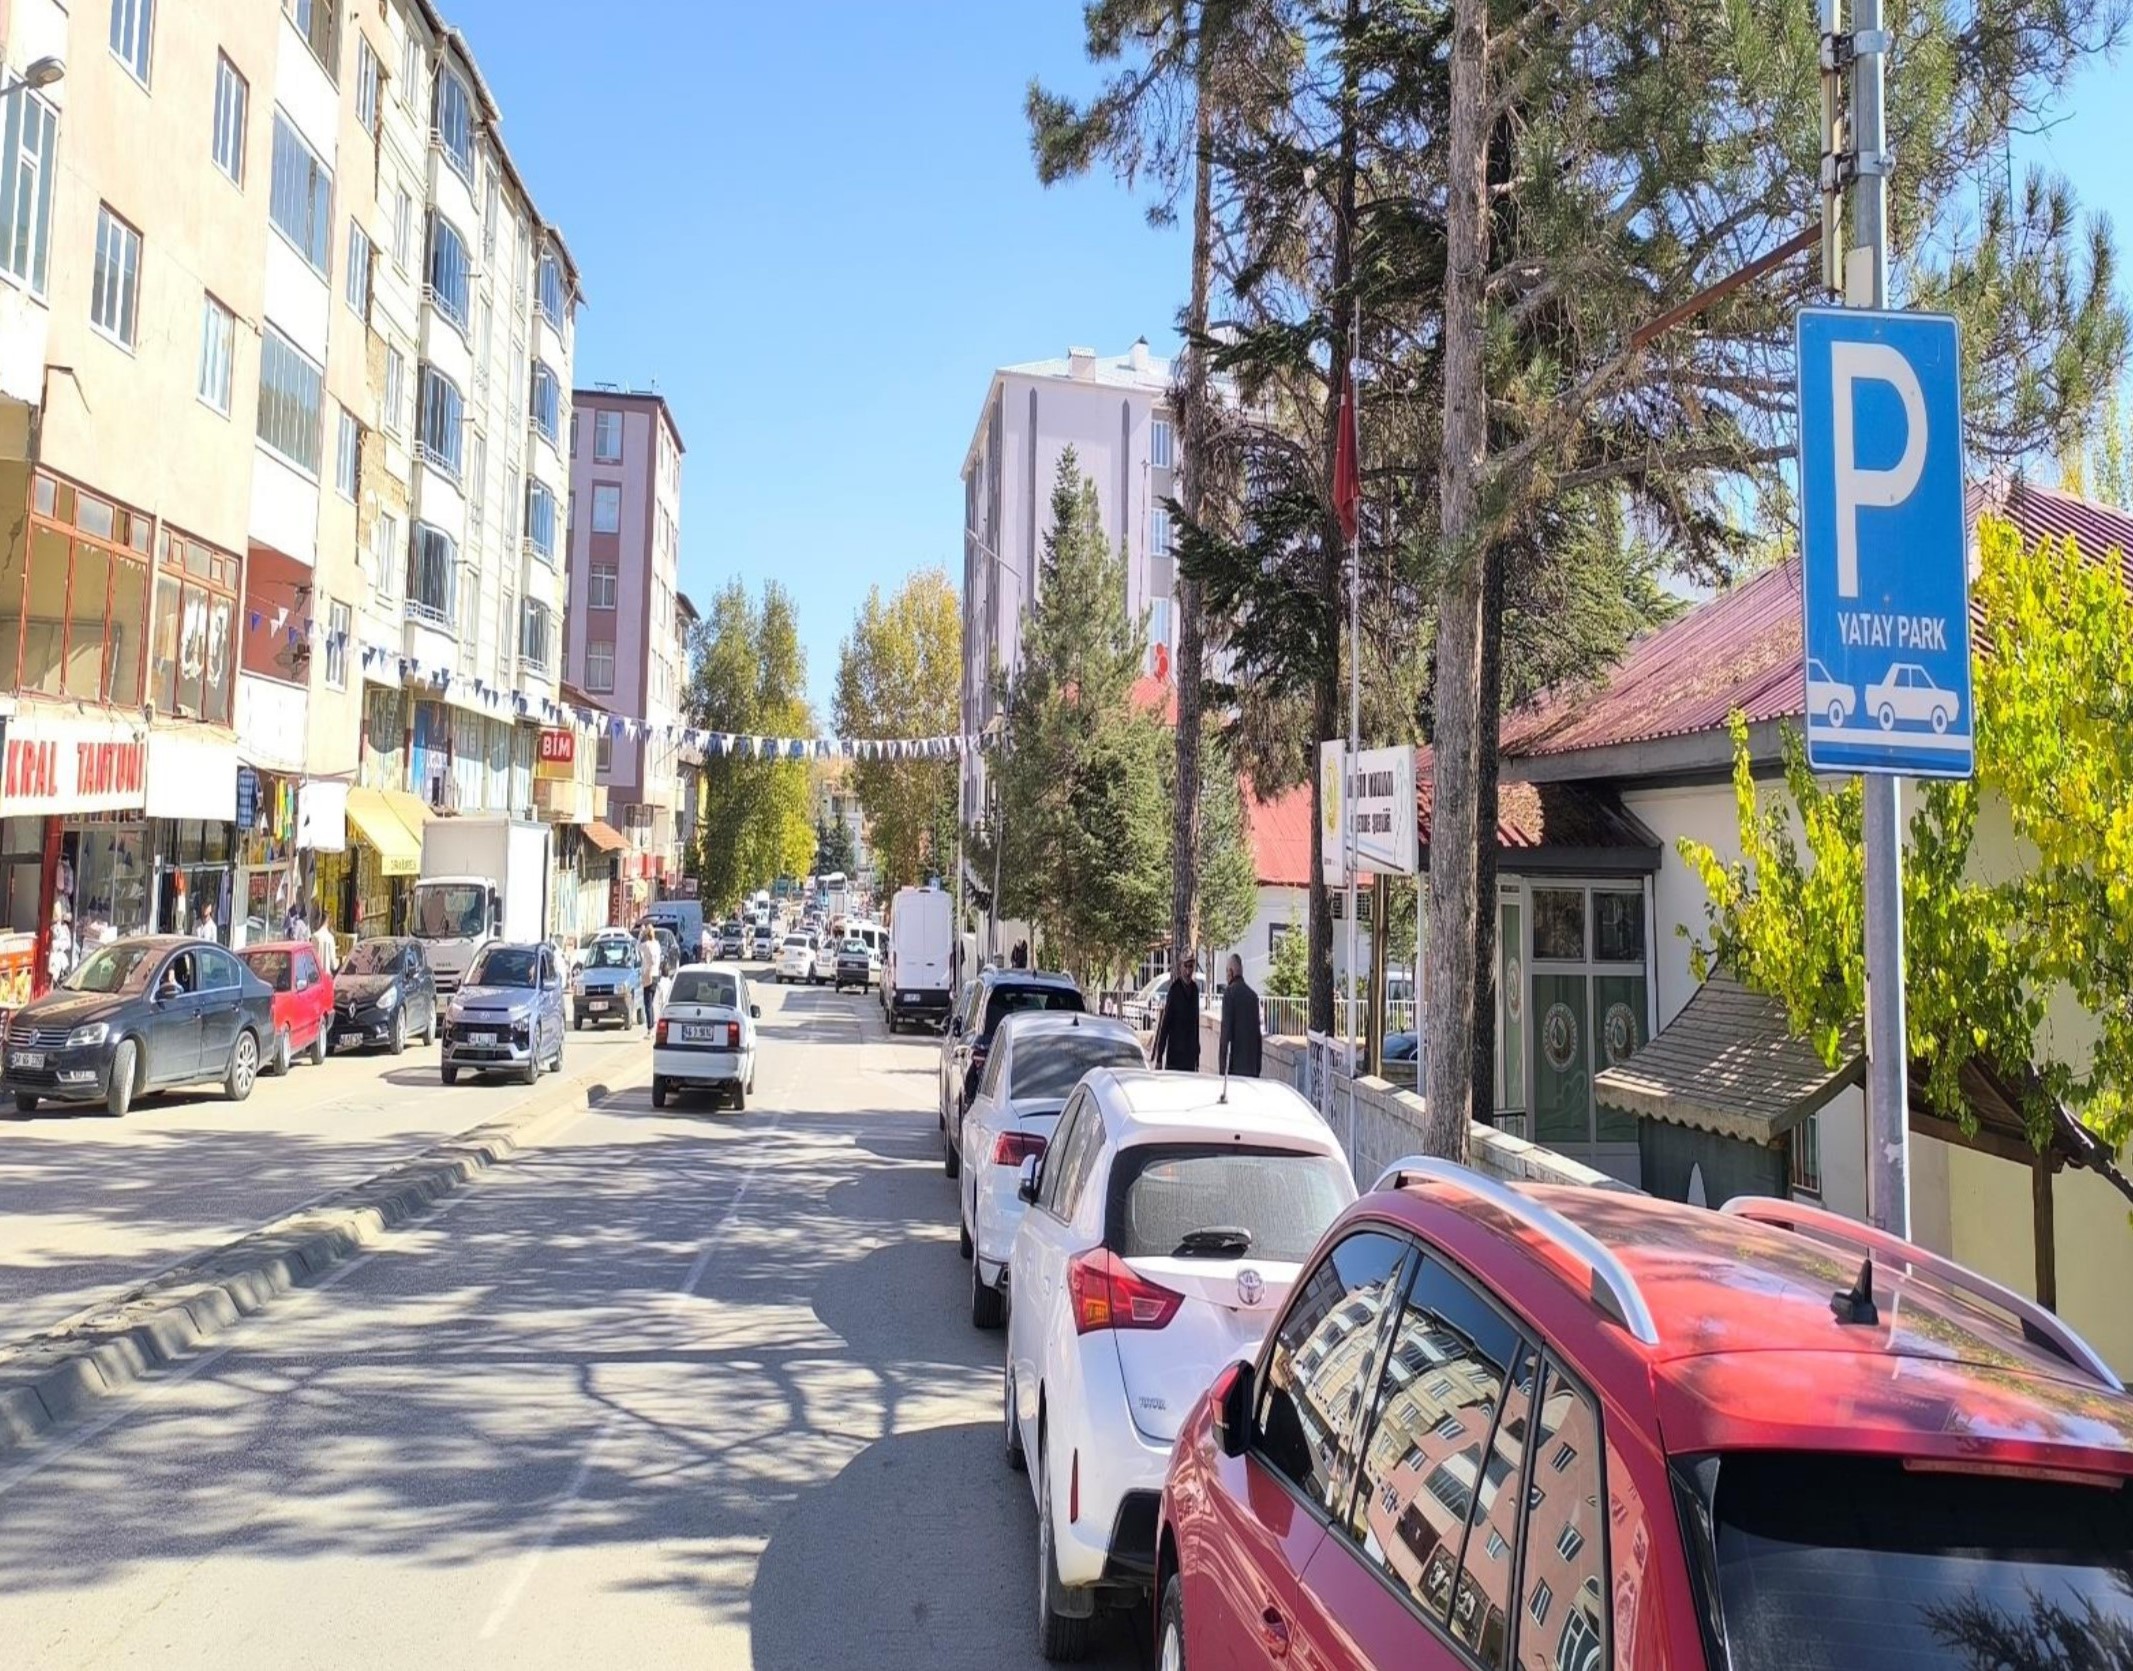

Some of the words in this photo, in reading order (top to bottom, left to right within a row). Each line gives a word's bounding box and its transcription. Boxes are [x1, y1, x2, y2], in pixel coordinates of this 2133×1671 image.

[1831, 341, 1929, 598] P
[1837, 611, 1894, 648] YATAY
[1897, 615, 1947, 651] PARK
[5, 739, 57, 798] KRAL
[542, 731, 571, 757] BİM
